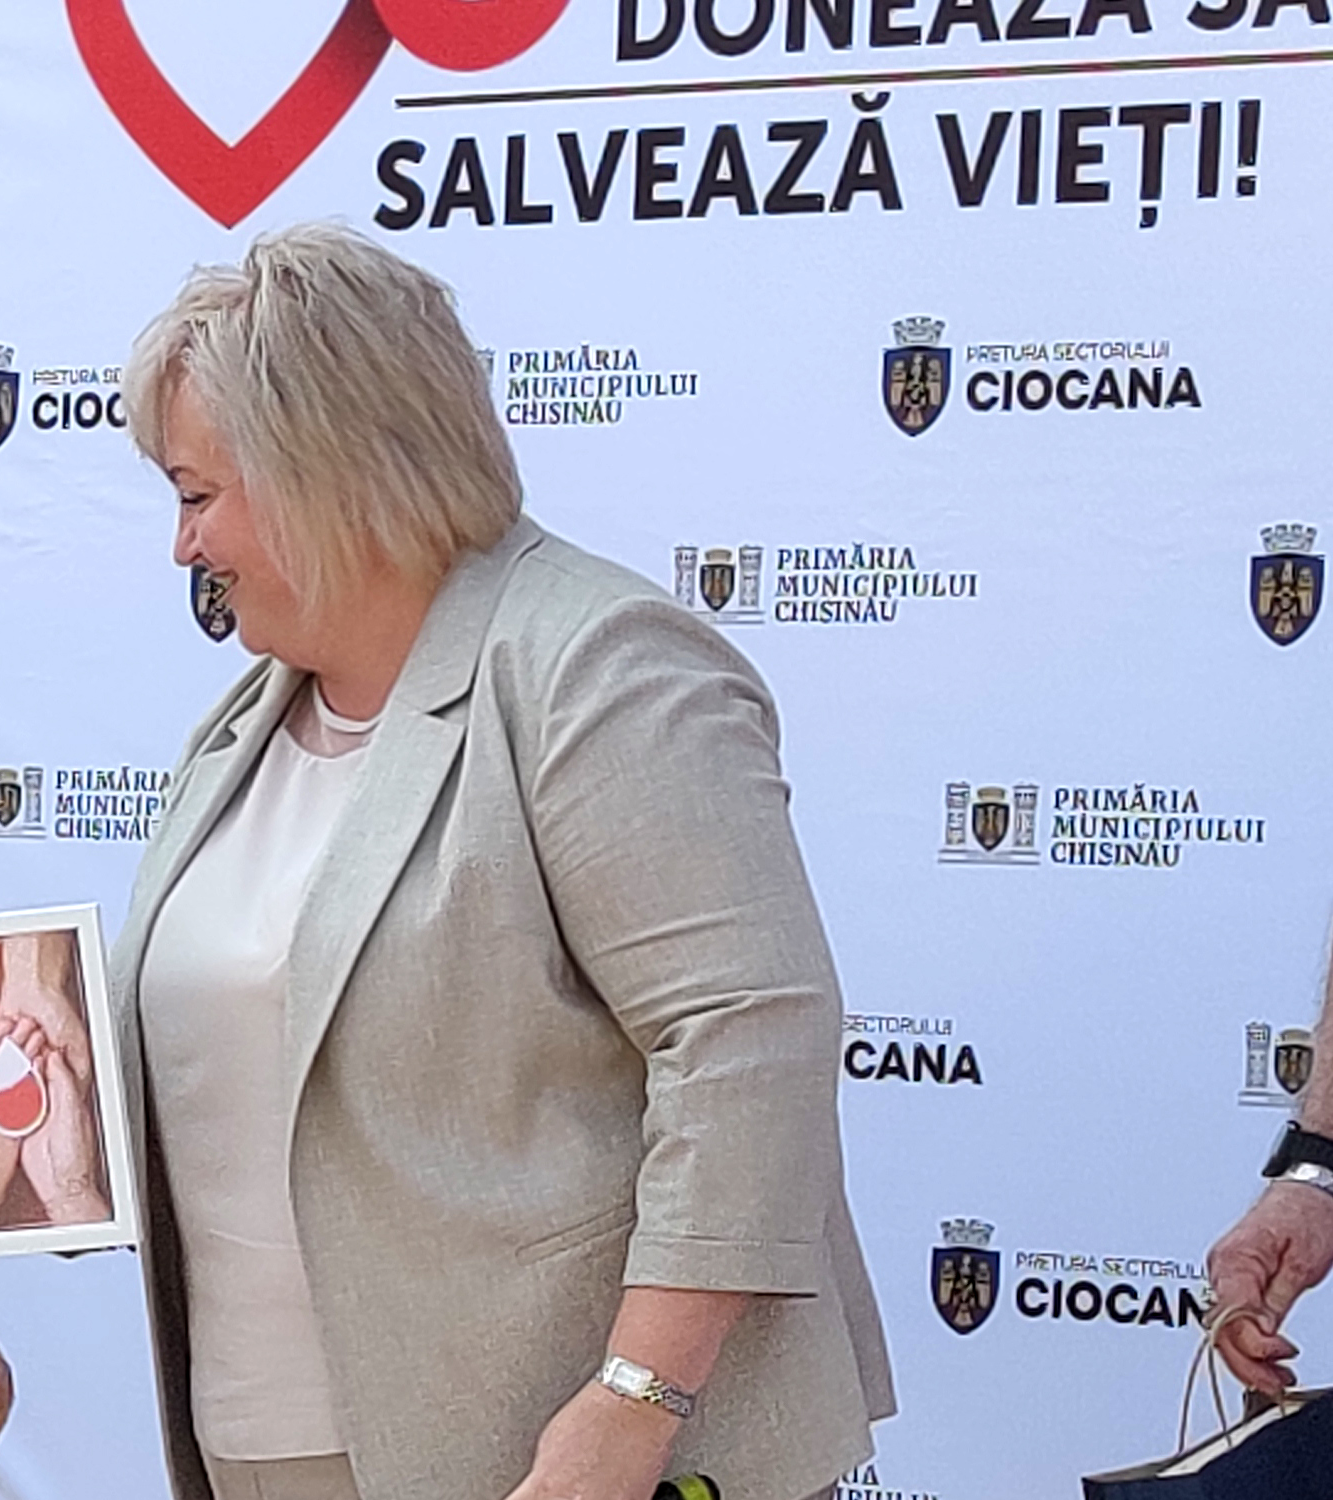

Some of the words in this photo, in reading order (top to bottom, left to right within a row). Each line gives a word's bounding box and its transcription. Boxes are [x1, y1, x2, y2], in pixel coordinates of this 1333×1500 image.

[616, 0, 1153, 61] DONE
[374, 92, 903, 231] SALVEAZĂ
[936, 99, 1260, 228] VIEȚI!
[508, 344, 641, 373] PRIMĂRIA
[966, 344, 1049, 363] PRETURA
[507, 374, 698, 400] MUNICIPIULUI
[966, 366, 1202, 412] CIOCANA
[777, 542, 917, 570] PRIMĂRIA
[775, 572, 978, 597] MUNICIPIULUI
[1053, 783, 1200, 813] PRIMĂRIA
[1051, 814, 1267, 843] MUNICIPIULUI
[844, 1039, 984, 1085] CANA
[1016, 1251, 1099, 1273] PRETURA
